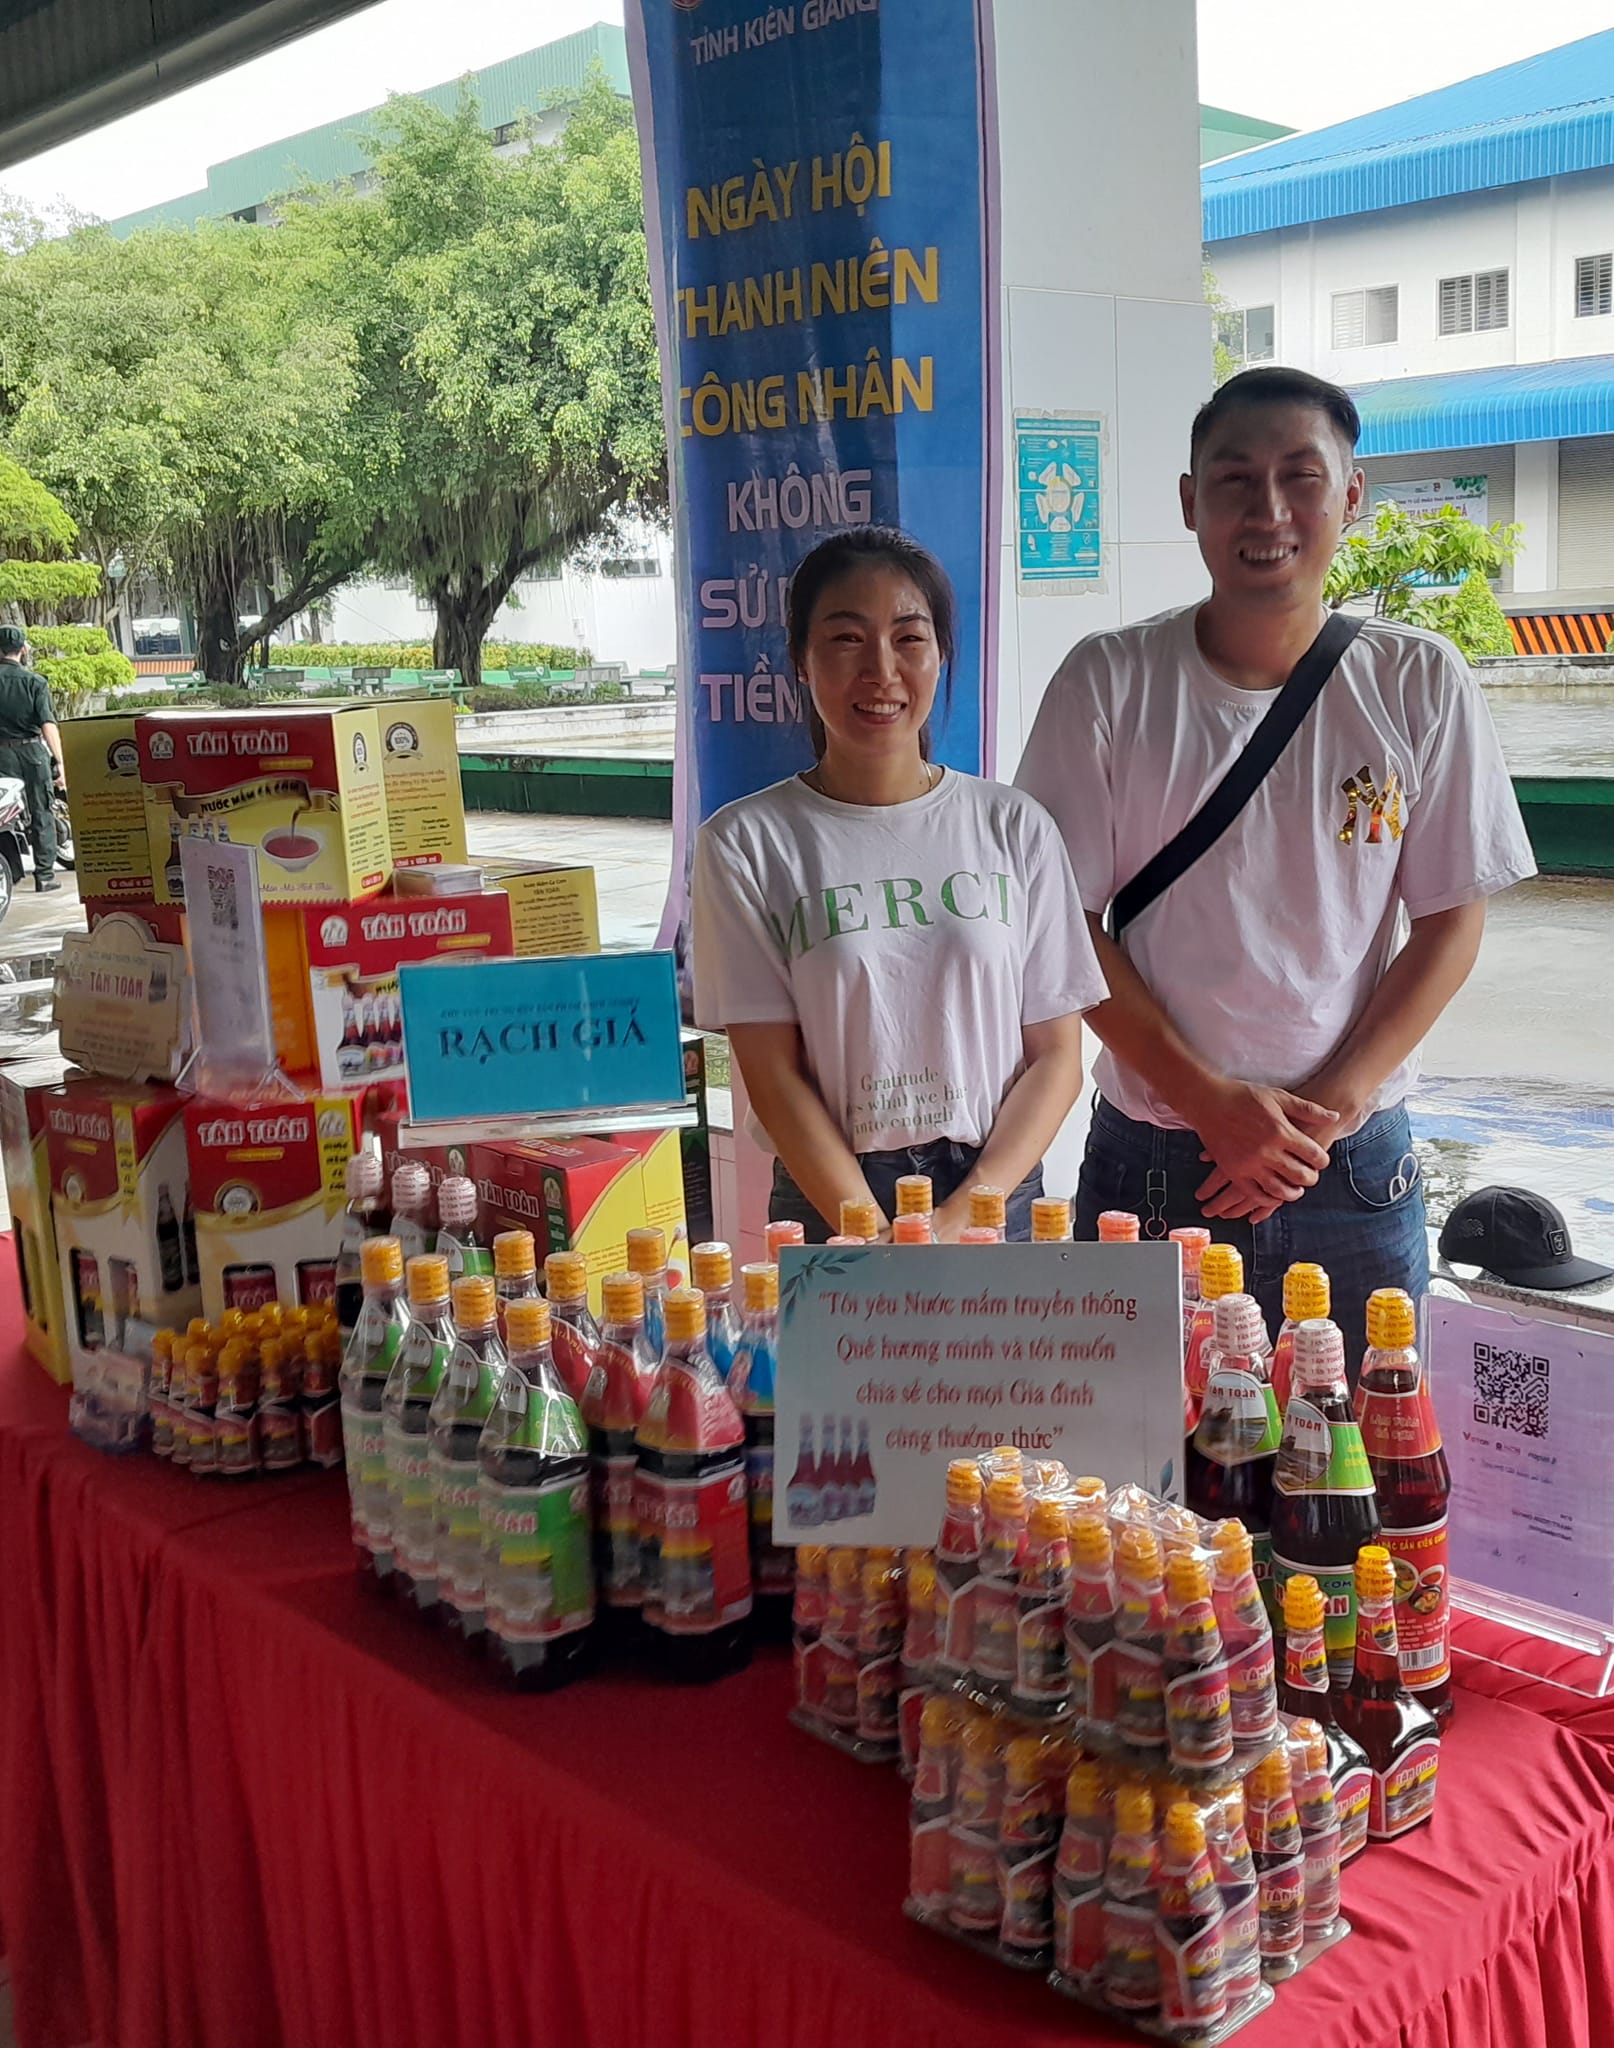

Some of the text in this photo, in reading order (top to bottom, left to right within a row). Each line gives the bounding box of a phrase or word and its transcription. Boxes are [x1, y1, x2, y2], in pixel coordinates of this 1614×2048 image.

[690, 24, 738, 65] TỈNH
[744, 6, 795, 48] KIÊN
[686, 131, 892, 240] NGÀY HỘI
[811, 237, 939, 317] NIÊN
[799, 346, 934, 424] NHÂN
[728, 463, 873, 533] KHÔNG
[701, 562, 771, 629] SỬ
[699, 652, 803, 723] TIỀN
[186, 729, 289, 755] TÂN TOÀN
[361, 907, 466, 941] TÂN TOÀN
[771, 871, 1012, 960] MERCI
[439, 1020, 559, 1065] RẠCH
[572, 1005, 647, 1049] GIÁ
[860, 1066, 939, 1092] Gratitude
[49, 1108, 76, 1135] TÂN
[198, 1115, 310, 1147] TÂN TOÀN
[890, 1106, 954, 1129] enough
[478, 1178, 541, 1218] TÂN TOÀN
[864, 1291, 898, 1322] yêu
[904, 1291, 955, 1316] Nước
[960, 1286, 1008, 1315] mắm
[1014, 1288, 1075, 1322] truyền
[1081, 1289, 1138, 1321] thống
[836, 1334, 874, 1365] Quê
[881, 1334, 940, 1365] hương
[1001, 1337, 1023, 1360] và
[1029, 1335, 1056, 1360] tôi
[1061, 1333, 1117, 1360] muốn
[856, 1378, 896, 1404] chia
[927, 1378, 961, 1404] cho
[967, 1380, 1004, 1408] mọi
[1009, 1378, 1045, 1405] Gia
